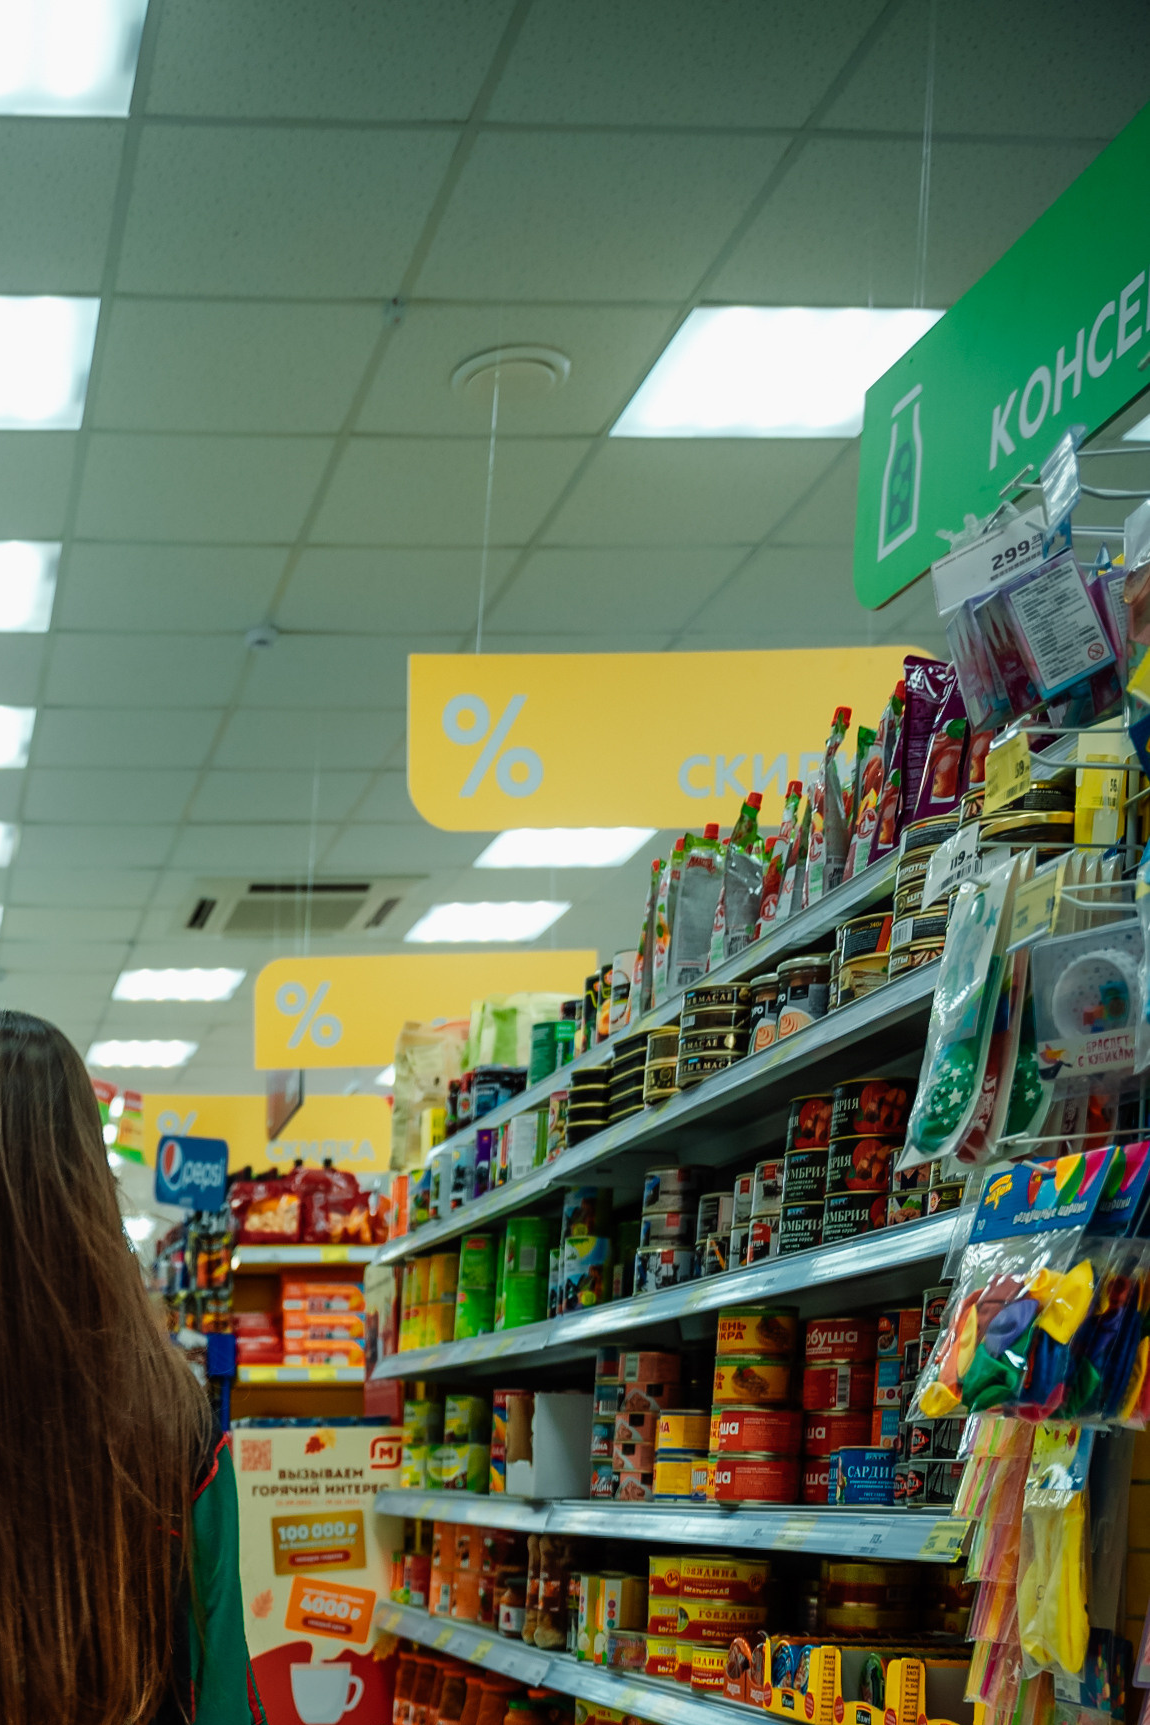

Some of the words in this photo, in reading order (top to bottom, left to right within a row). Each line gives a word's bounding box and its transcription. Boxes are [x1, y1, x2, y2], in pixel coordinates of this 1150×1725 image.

[988, 264, 1150, 471] КОНСЕ
[991, 540, 1030, 571] 299
[442, 693, 544, 798] %
[950, 851, 966, 872] 119
[1085, 1034, 1131, 1053] БРАСЛЕТ
[182, 1157, 225, 1192] pepsi
[278, 1468, 364, 1480] ВЫЗЫВАЕМ
[252, 1483, 320, 1497] ГОРЯЧИЙ
[277, 1523, 309, 1542] 100
[311, 1521, 346, 1540] 000
[299, 1594, 350, 1619] 4000
